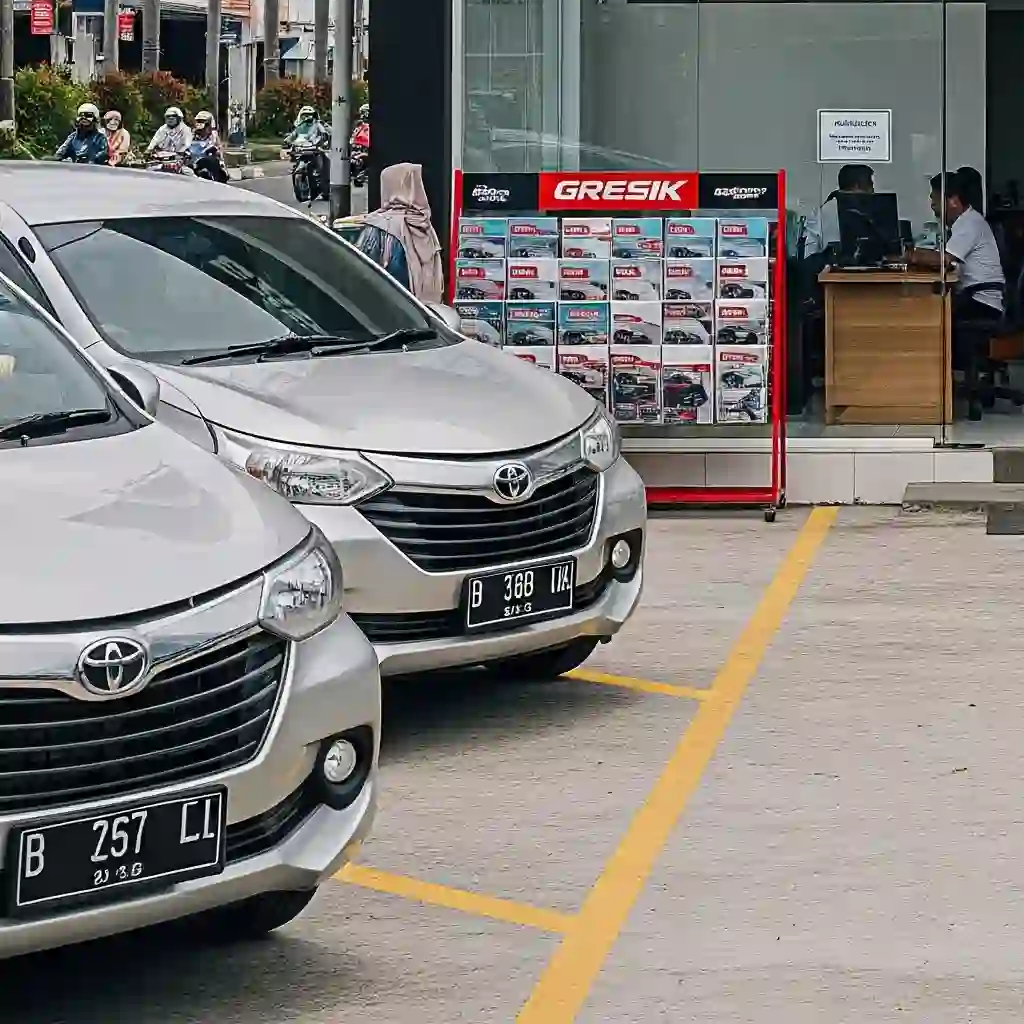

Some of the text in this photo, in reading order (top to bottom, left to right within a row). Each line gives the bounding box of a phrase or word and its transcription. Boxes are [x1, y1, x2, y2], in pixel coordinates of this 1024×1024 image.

[553, 179, 689, 202] GRESIK
[25, 833, 45, 878] B
[90, 810, 148, 862] 257
